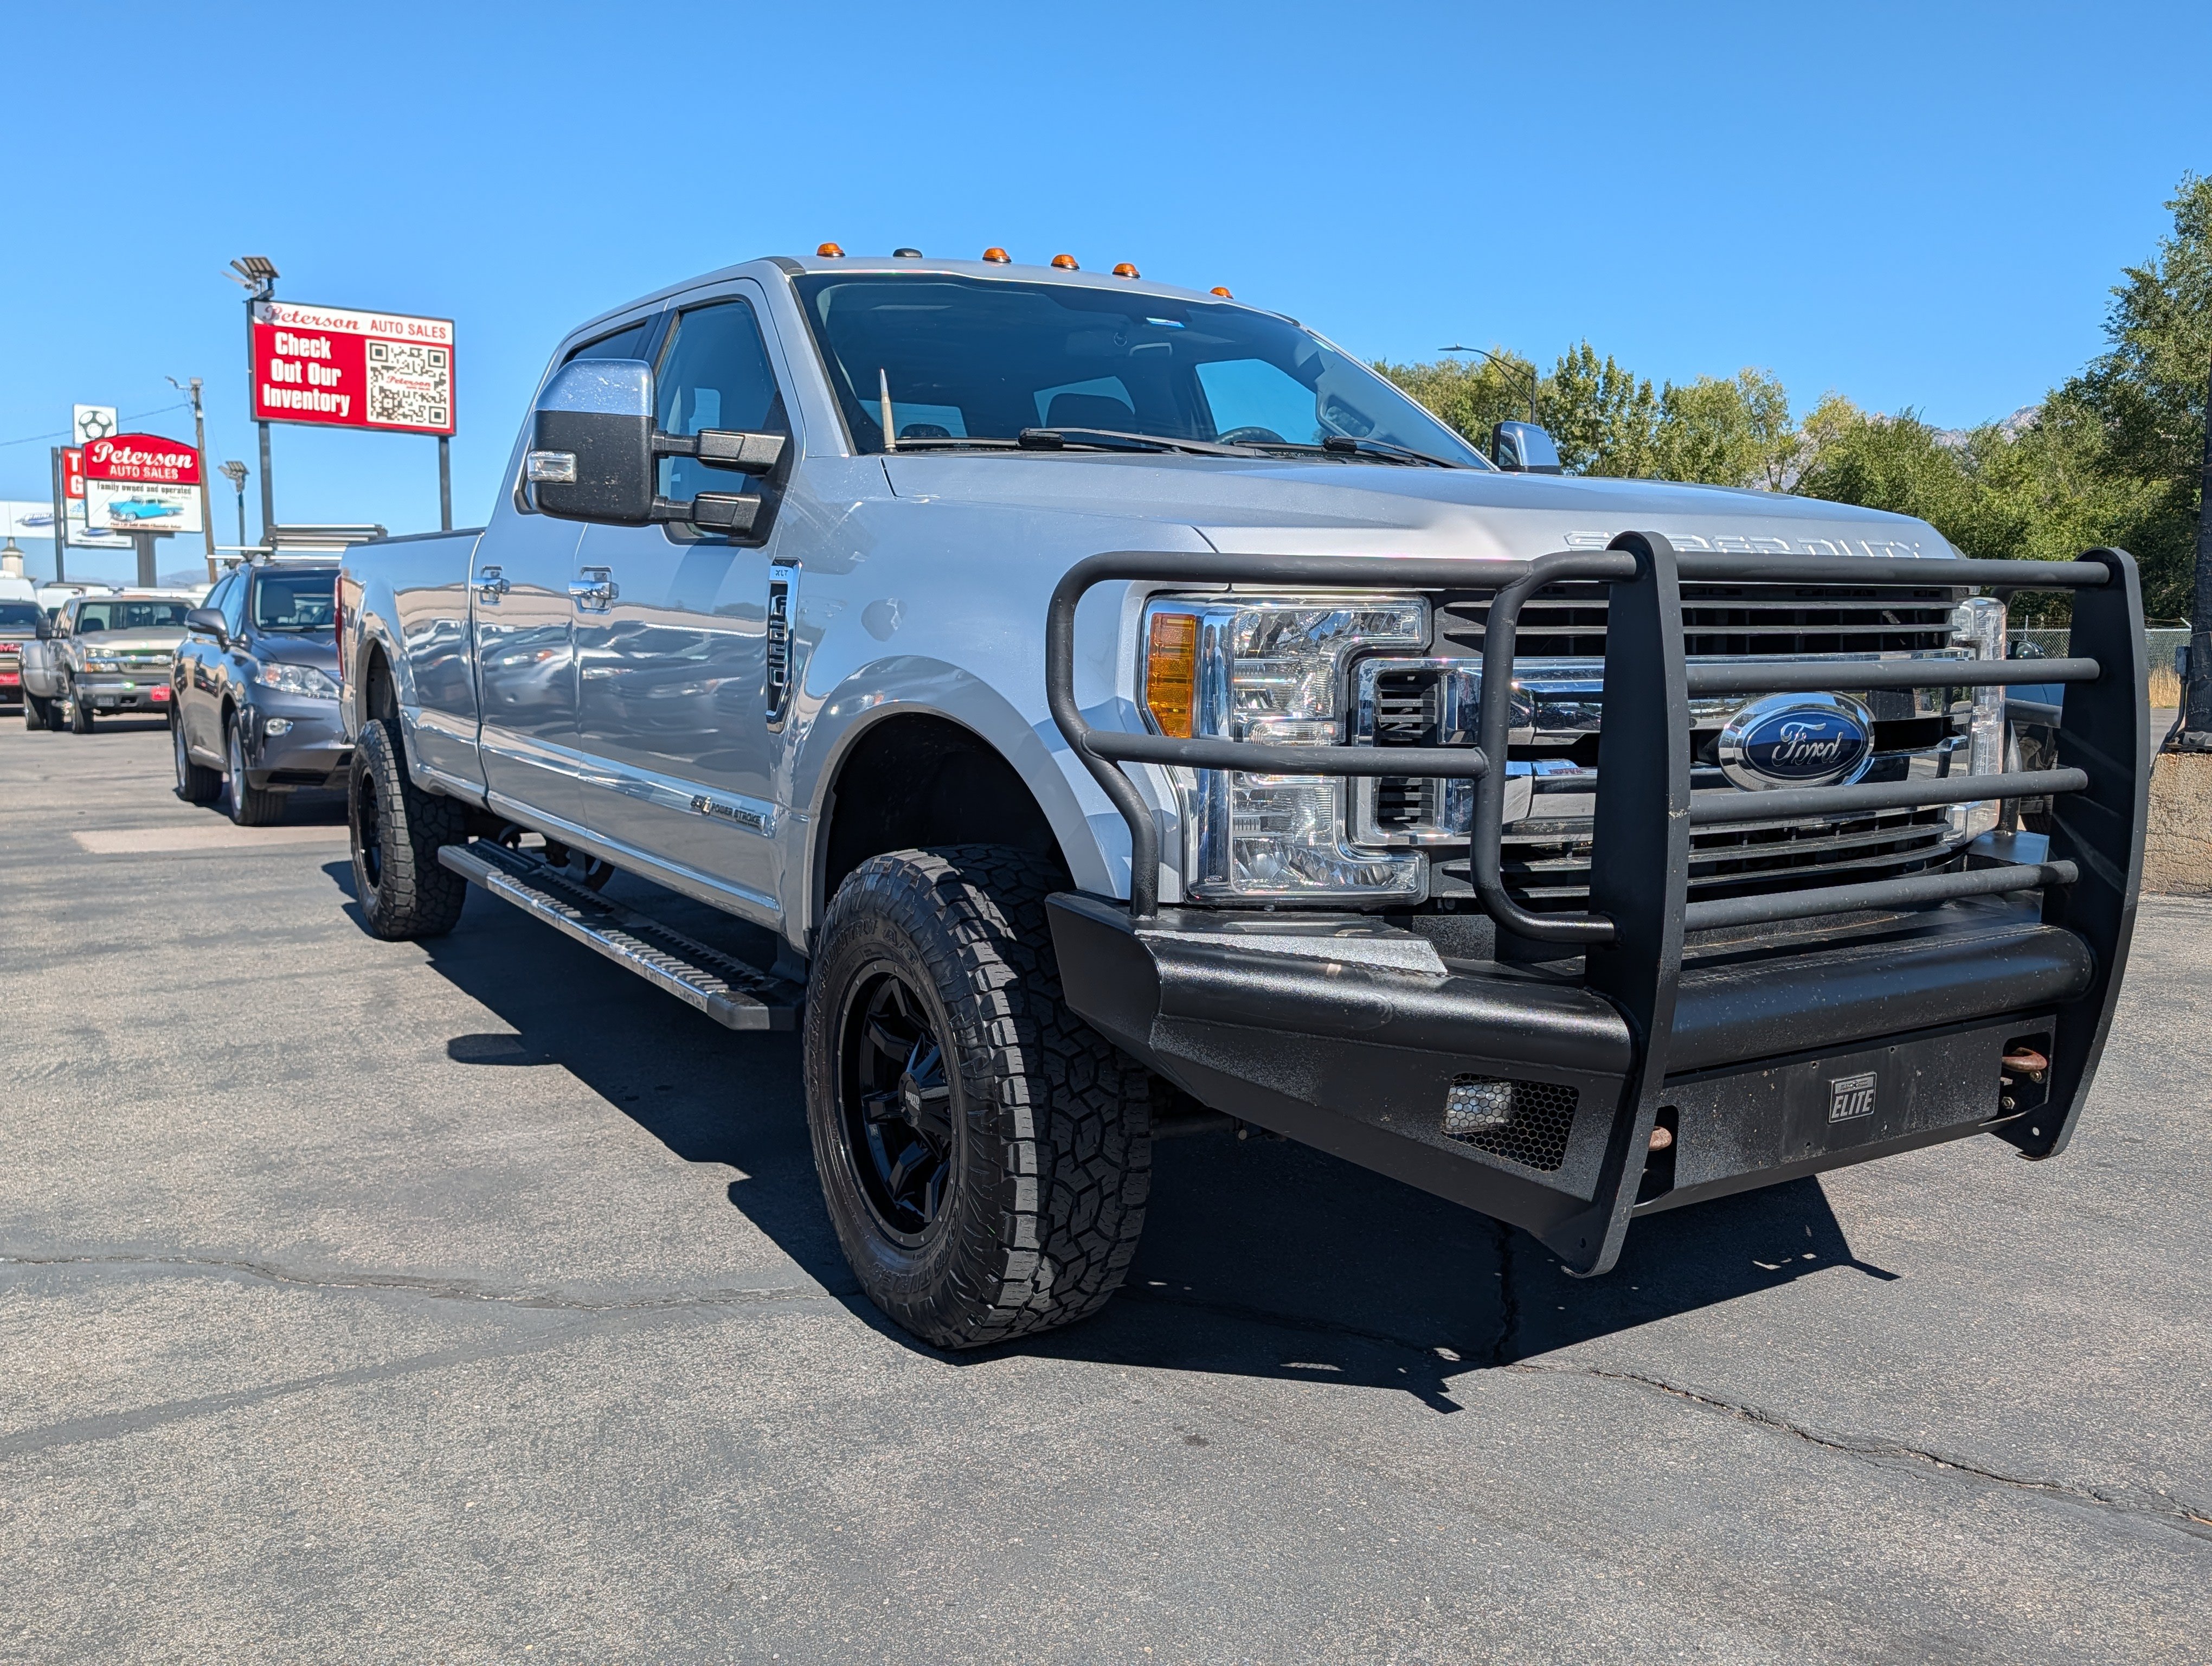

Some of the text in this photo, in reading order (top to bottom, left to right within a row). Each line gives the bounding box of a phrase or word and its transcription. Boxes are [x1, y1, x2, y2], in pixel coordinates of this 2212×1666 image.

[263, 304, 446, 339] Peterson AUTO SALES
[275, 331, 332, 360] Check
[271, 358, 342, 387] Out Our
[262, 383, 351, 417] Inventory
[92, 441, 194, 469] Peterson
[110, 465, 178, 480] AUTO SALES
[97, 481, 192, 495] Family owned and operated
[1771, 721, 1844, 767] Ford
[711, 802, 734, 816] POWER
[734, 809, 762, 824] STROKE
[905, 1090, 920, 1105] MOTO
[1831, 1089, 1874, 1119] ELITE
